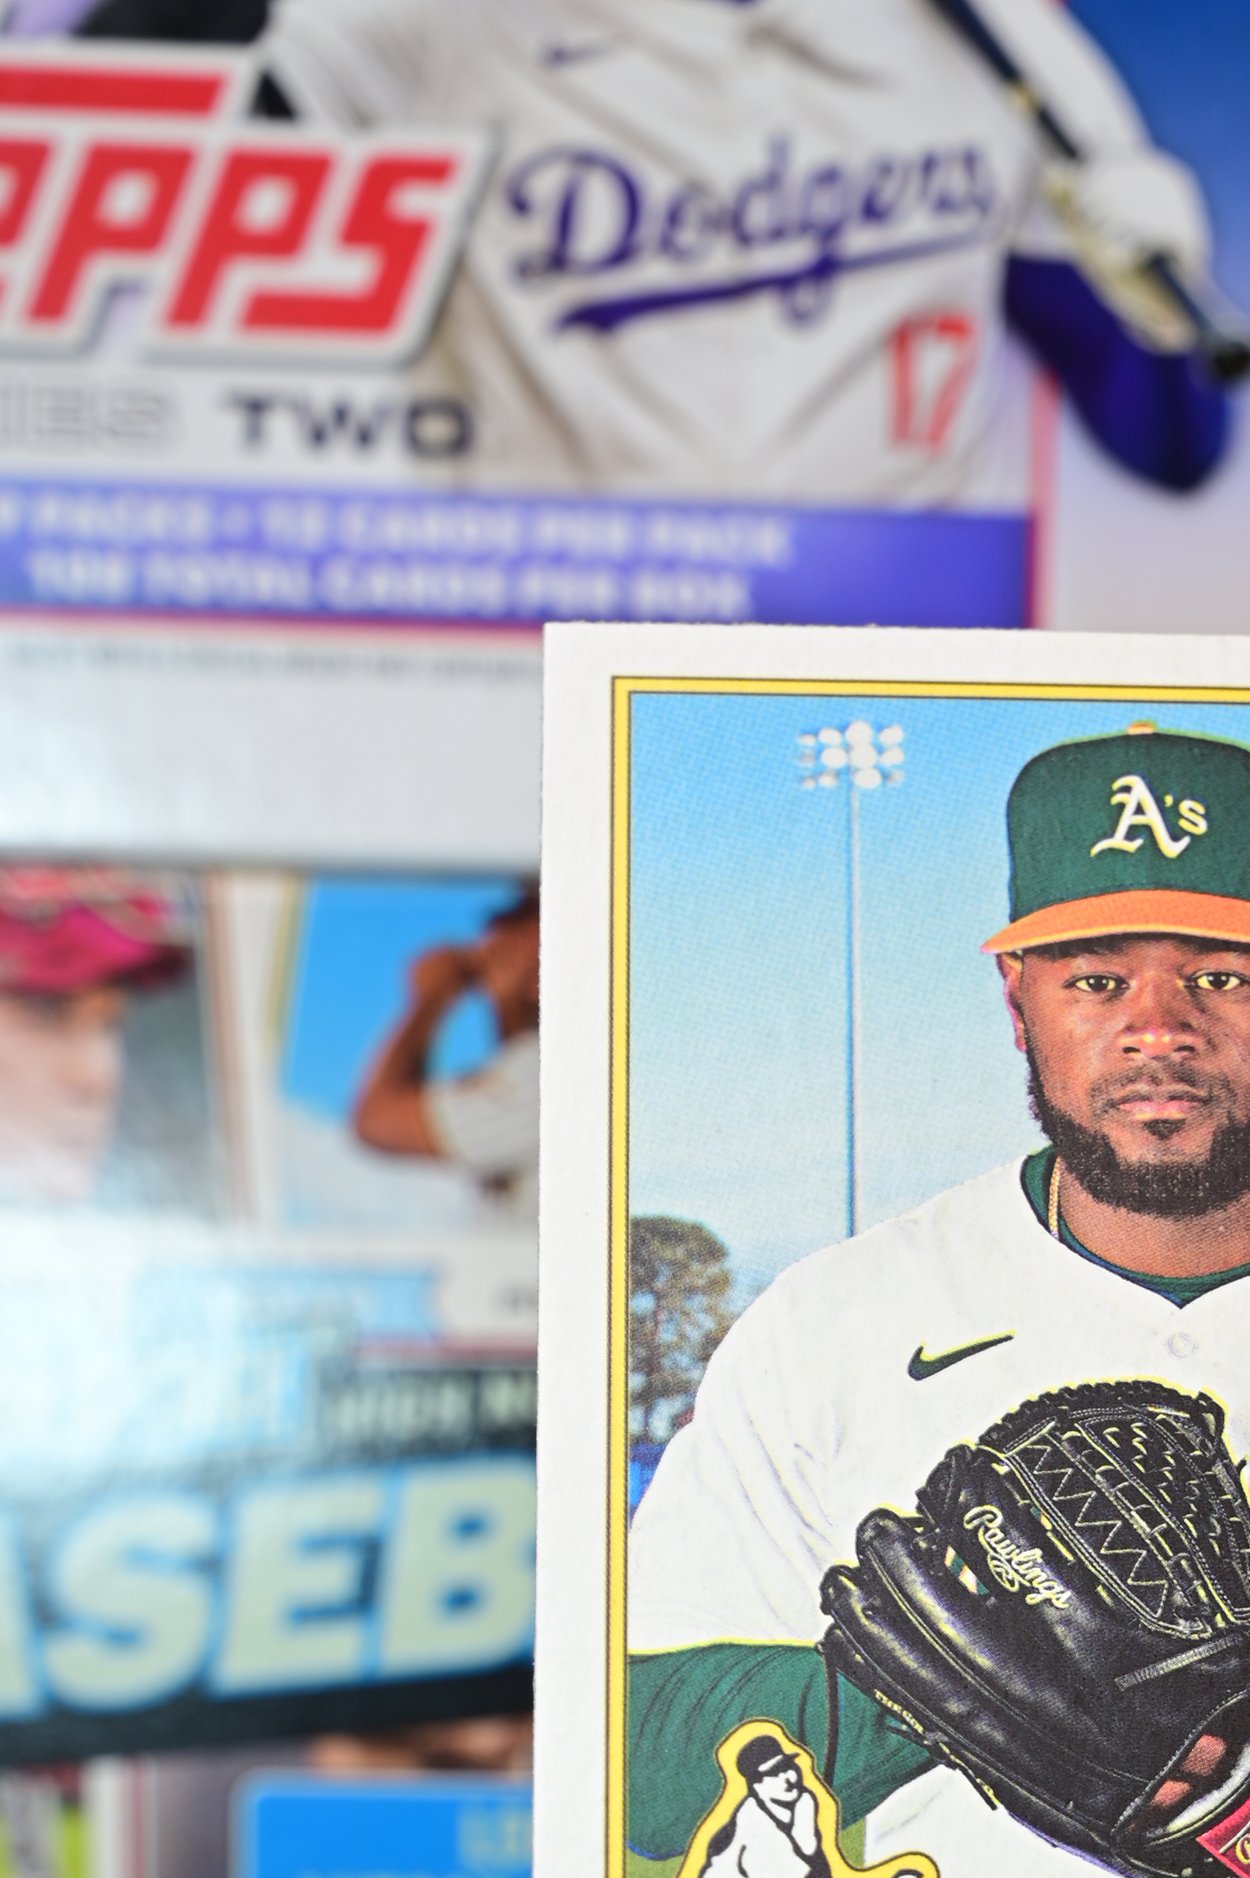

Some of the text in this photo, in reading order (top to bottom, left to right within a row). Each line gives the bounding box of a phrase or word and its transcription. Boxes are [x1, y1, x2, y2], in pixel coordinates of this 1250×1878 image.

[507, 134, 996, 330] Dodgers
[226, 388, 477, 457] TWO
[886, 310, 980, 456] 17
[1089, 774, 1209, 859] A's
[962, 1503, 1072, 1610] Rawlings
